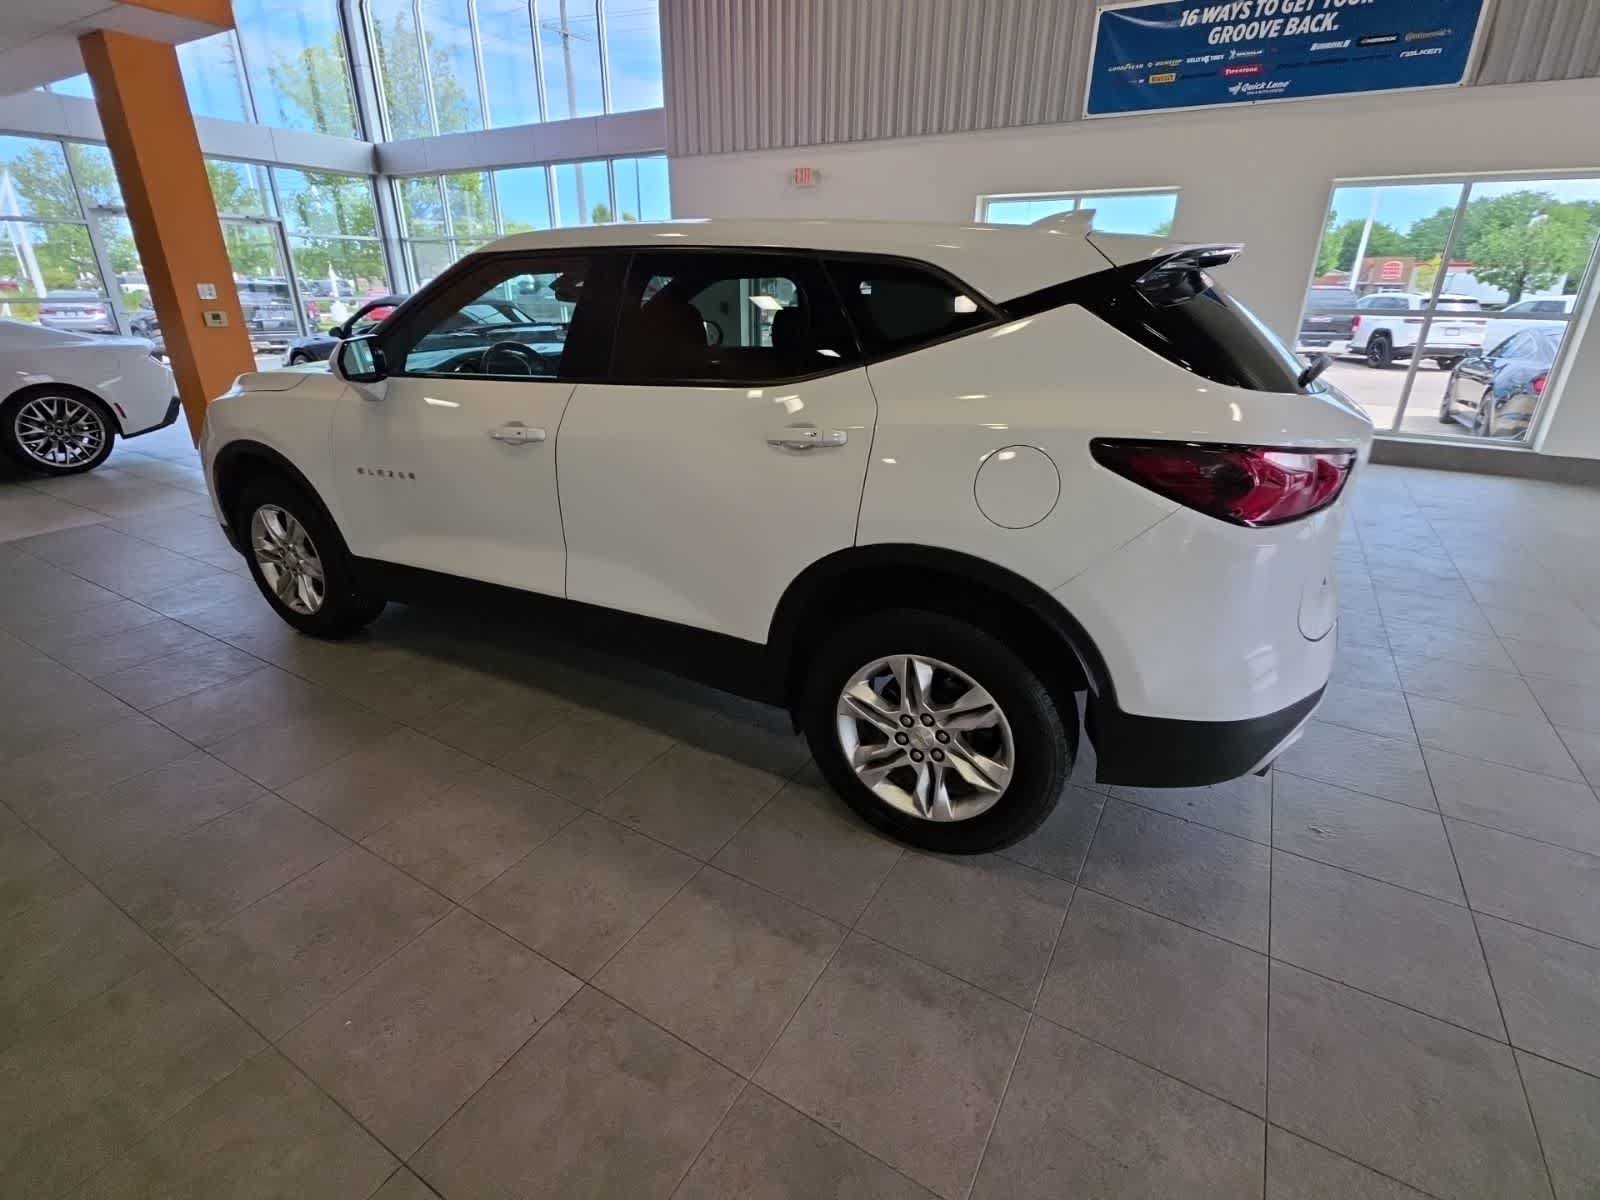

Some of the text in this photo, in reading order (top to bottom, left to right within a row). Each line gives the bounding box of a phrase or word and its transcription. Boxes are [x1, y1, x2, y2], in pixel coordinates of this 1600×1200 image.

[1180, 9, 1200, 28] 16
[1201, 1, 1253, 24] WAYS
[1254, 0, 1279, 17] TO
[1281, 0, 1315, 14] GET
[1208, 12, 1340, 45] GROOVE BACK.
[1241, 82, 1267, 92] Quick
[1266, 80, 1290, 89] Lane
